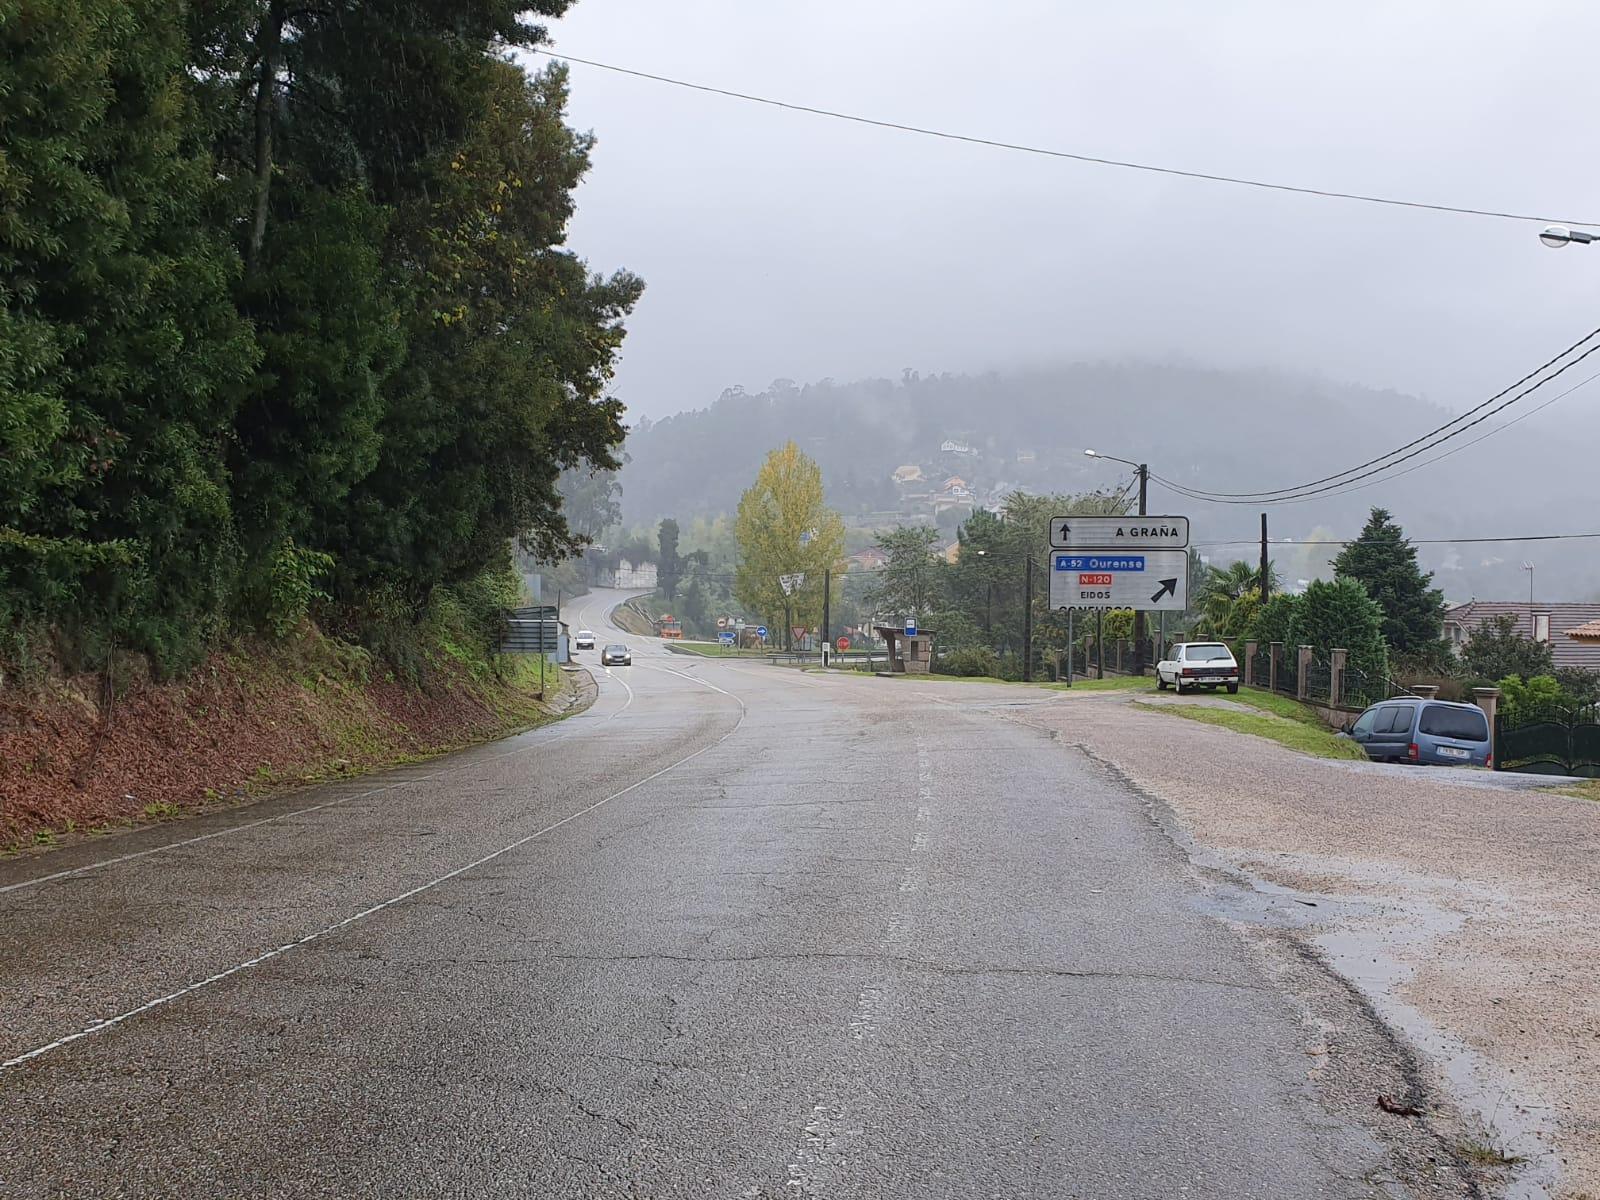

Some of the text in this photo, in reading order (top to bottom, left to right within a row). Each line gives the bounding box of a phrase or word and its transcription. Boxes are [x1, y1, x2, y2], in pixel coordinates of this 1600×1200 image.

[1116, 525, 1178, 537] A GRAÑA
[1060, 558, 1142, 569] A-52 Ourense
[1081, 575, 1111, 584] N-120
[1080, 591, 1111, 600] EIDOS
